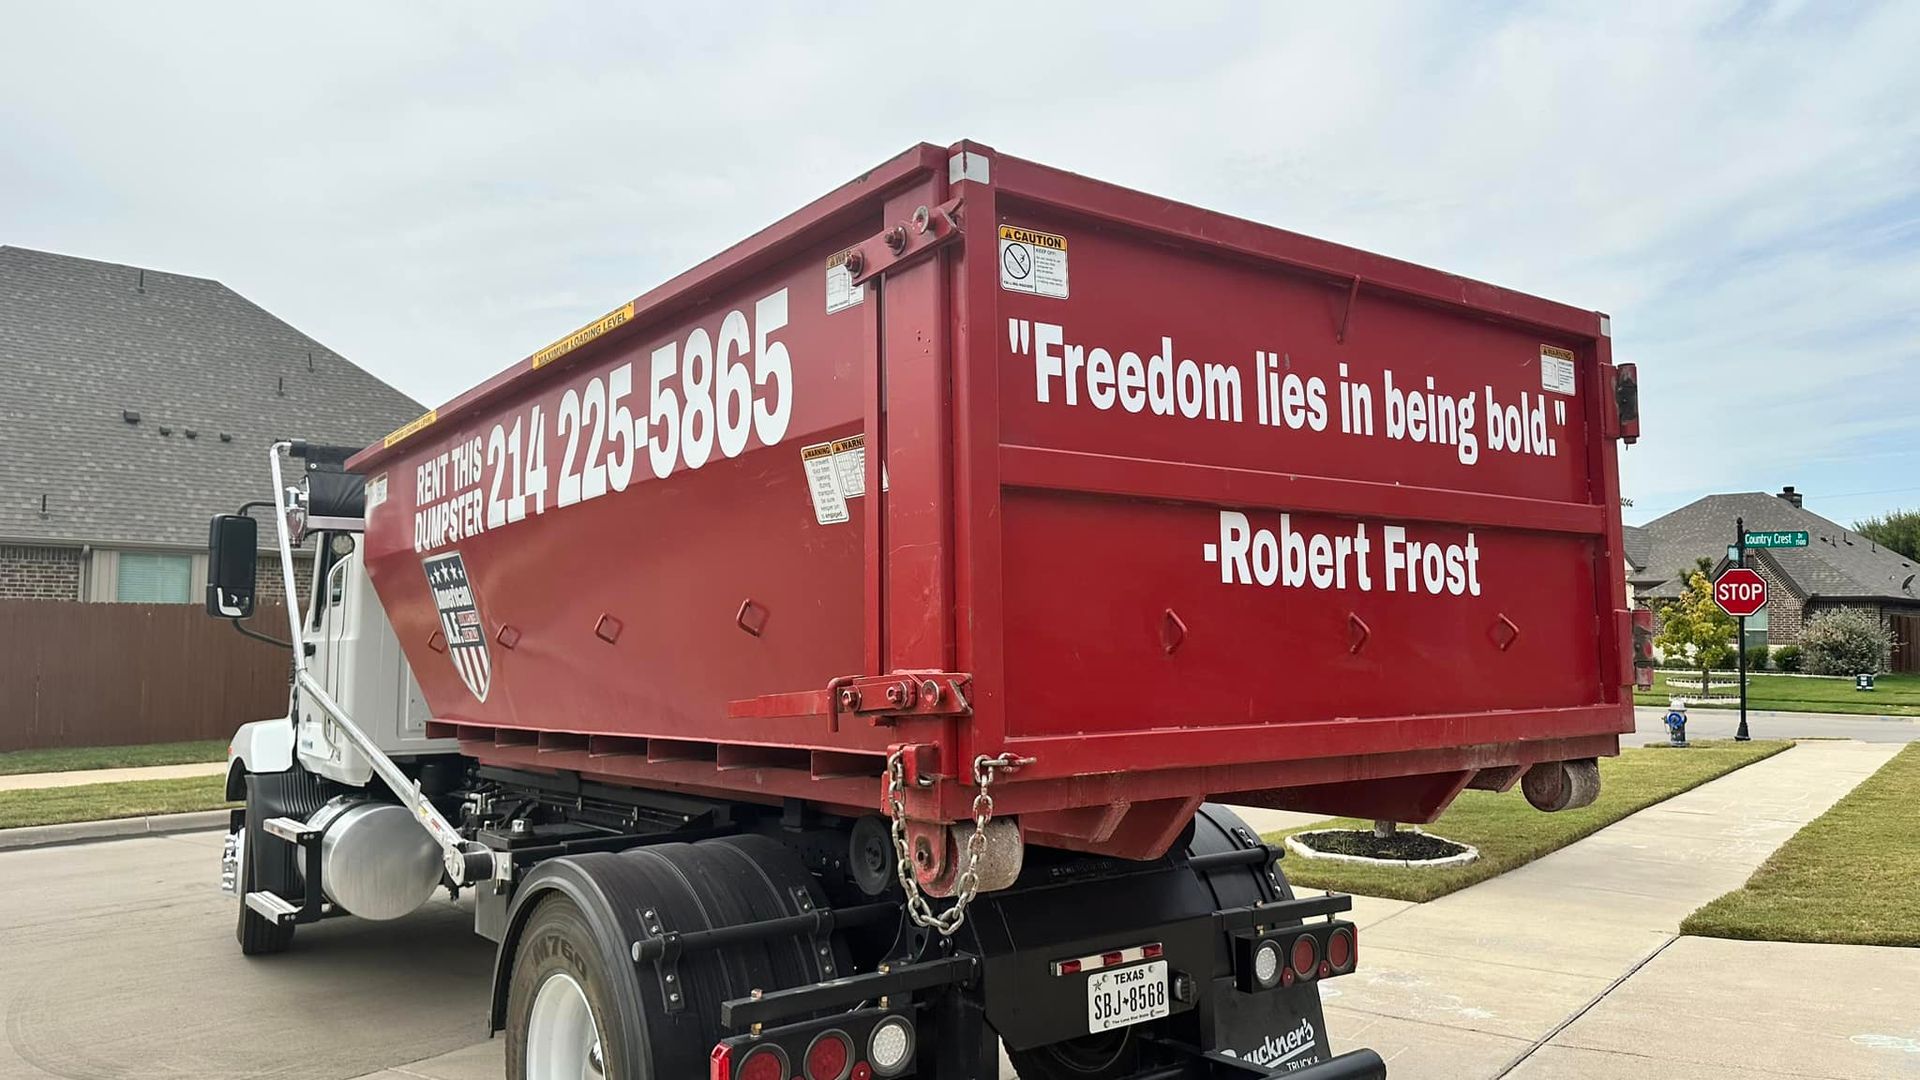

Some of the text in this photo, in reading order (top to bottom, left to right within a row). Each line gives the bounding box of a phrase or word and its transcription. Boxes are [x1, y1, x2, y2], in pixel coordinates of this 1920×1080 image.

[1014, 230, 1061, 248] CAUTION
[538, 312, 627, 364] MAXIMUM LOADING LEVEL
[487, 287, 793, 530] 214 225-5865
[1008, 318, 1566, 466] "Freedom lies in being bold."
[808, 447, 830, 457] WARNING
[841, 438, 865, 450] WARNI
[416, 453, 449, 506] RENT
[452, 436, 482, 492] THIS
[415, 488, 484, 553] DUMPSTER
[1203, 510, 1481, 597] -Robert Frost
[1744, 533, 1792, 546] Country Crest
[1718, 583, 1763, 601] STOP
[1113, 968, 1144, 985] TEXAS
[1220, 1017, 1315, 1066] uckner's
[1286, 1057, 1312, 1071] TRUCK
